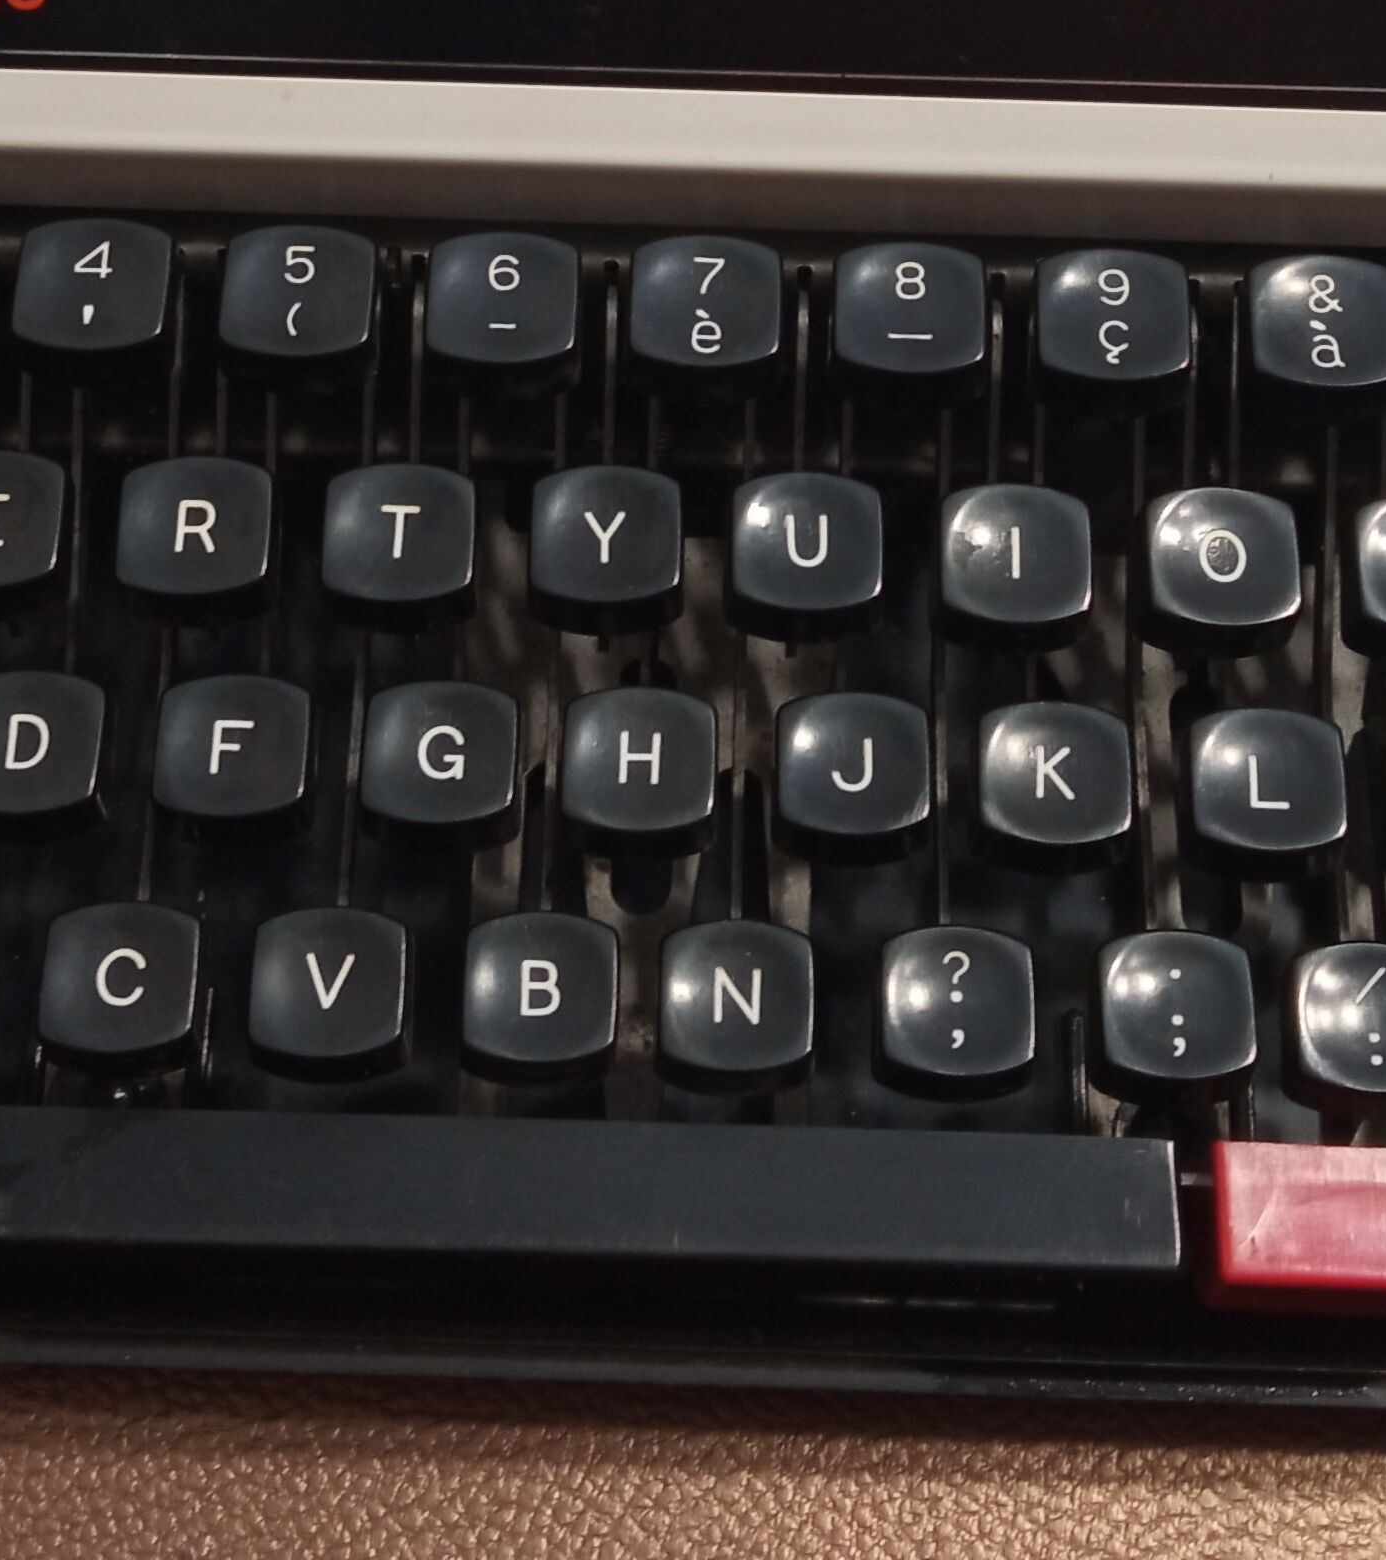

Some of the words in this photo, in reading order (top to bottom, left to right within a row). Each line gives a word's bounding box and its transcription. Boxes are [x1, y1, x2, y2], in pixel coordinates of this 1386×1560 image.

[75, 242, 112, 278] 4
[285, 246, 314, 283] 5
[489, 255, 519, 290] 6
[694, 257, 724, 293] 7
[896, 262, 925, 299] 8
[1099, 269, 1129, 305] 9
[1309, 274, 1343, 313] &
[287, 303, 301, 335] (
[692, 310, 721, 353] è
[1099, 321, 1128, 363] ç
[1310, 320, 1345, 367] à
[175, 500, 215, 552] R
[382, 505, 420, 558] T
[585, 512, 625, 563] Y
[786, 514, 828, 567] U
[1011, 527, 1020, 578] I
[1200, 530, 1246, 582] O
[6, 714, 48, 769] D
[210, 720, 253, 773] F
[418, 726, 464, 779] G
[619, 731, 660, 784] H
[832, 739, 872, 791] J
[1036, 745, 1074, 799] K
[1248, 755, 1290, 809] L
[97, 949, 145, 1005] C
[307, 954, 354, 1008] V
[521, 960, 559, 1015] B
[714, 967, 760, 1024] N
[943, 951, 969, 1002] ?
[1172, 1015, 1185, 1056] ;
[1369, 1033, 1382, 1065] :
